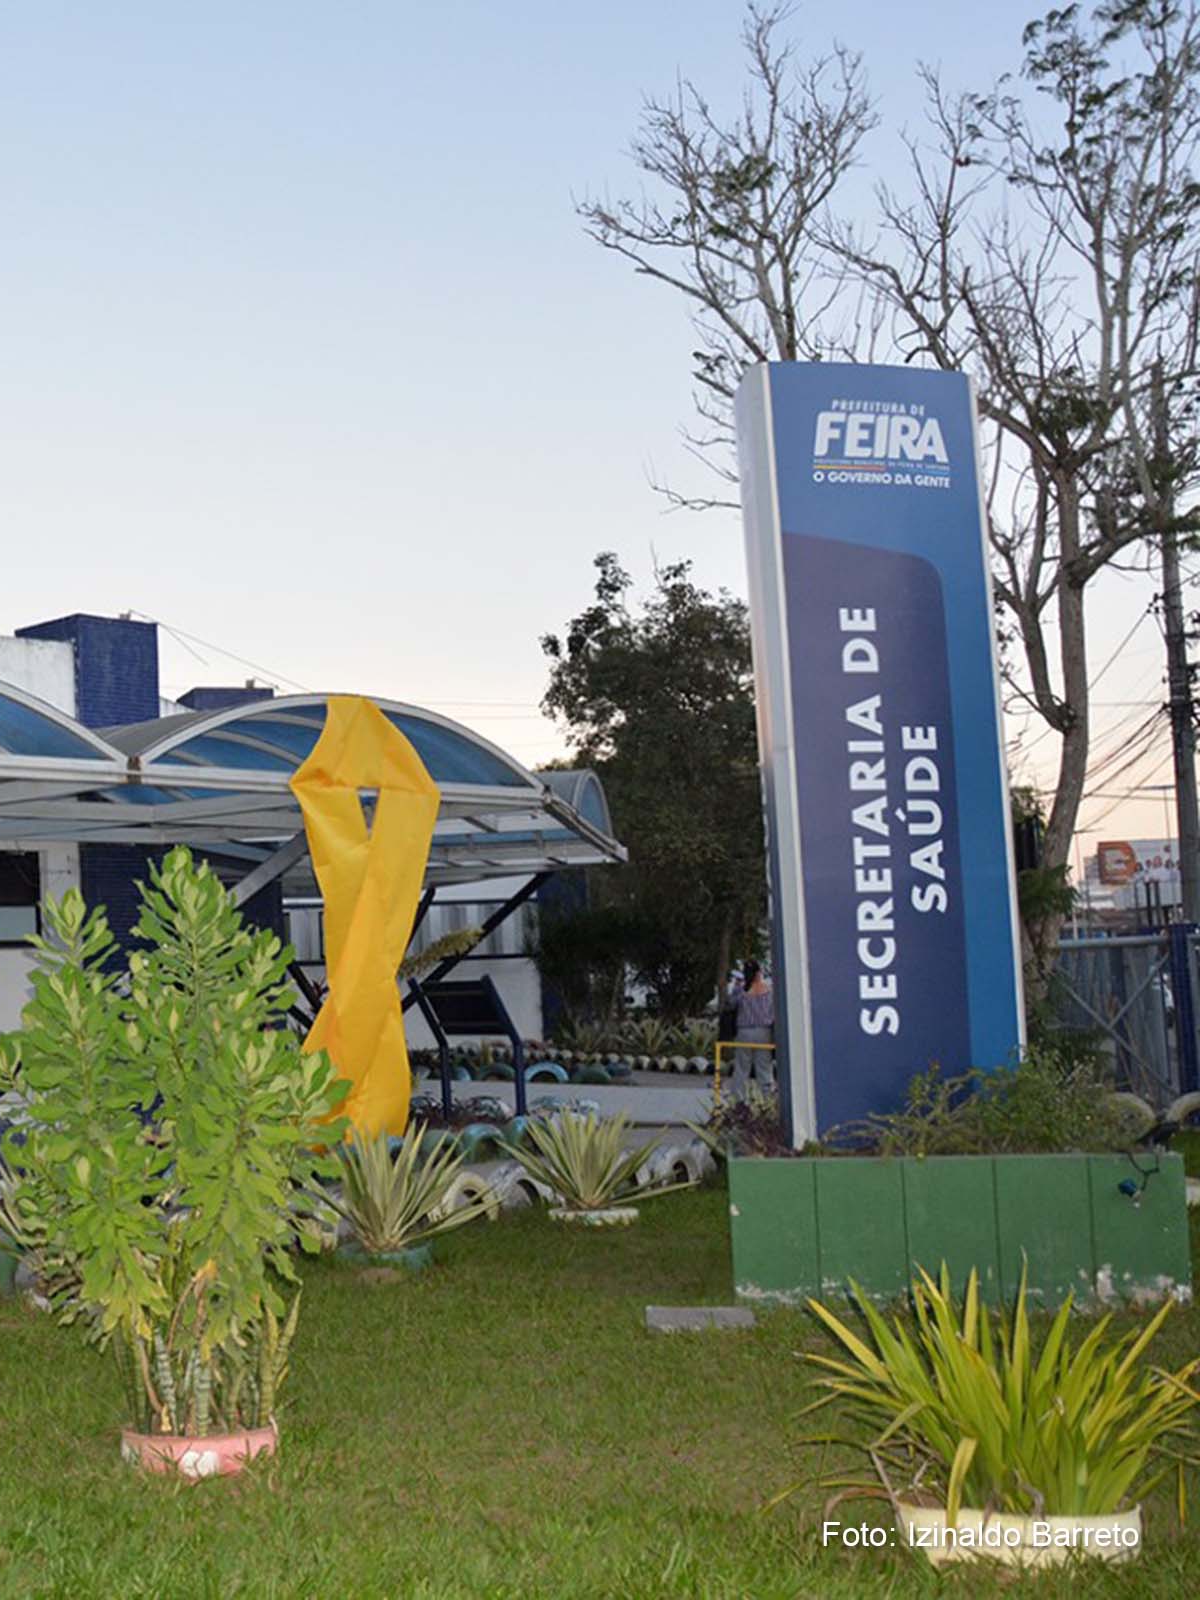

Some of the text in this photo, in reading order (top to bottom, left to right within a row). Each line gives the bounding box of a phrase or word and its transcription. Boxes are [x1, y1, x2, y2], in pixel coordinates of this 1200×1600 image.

[831, 400, 925, 416] PREFEITURA DE
[813, 411, 949, 463] FEIRA
[813, 471, 950, 488] O GOVERNO DA GENTE
[839, 607, 899, 1035] SECRETARIA DE
[895, 726, 947, 912] SAÚDE
